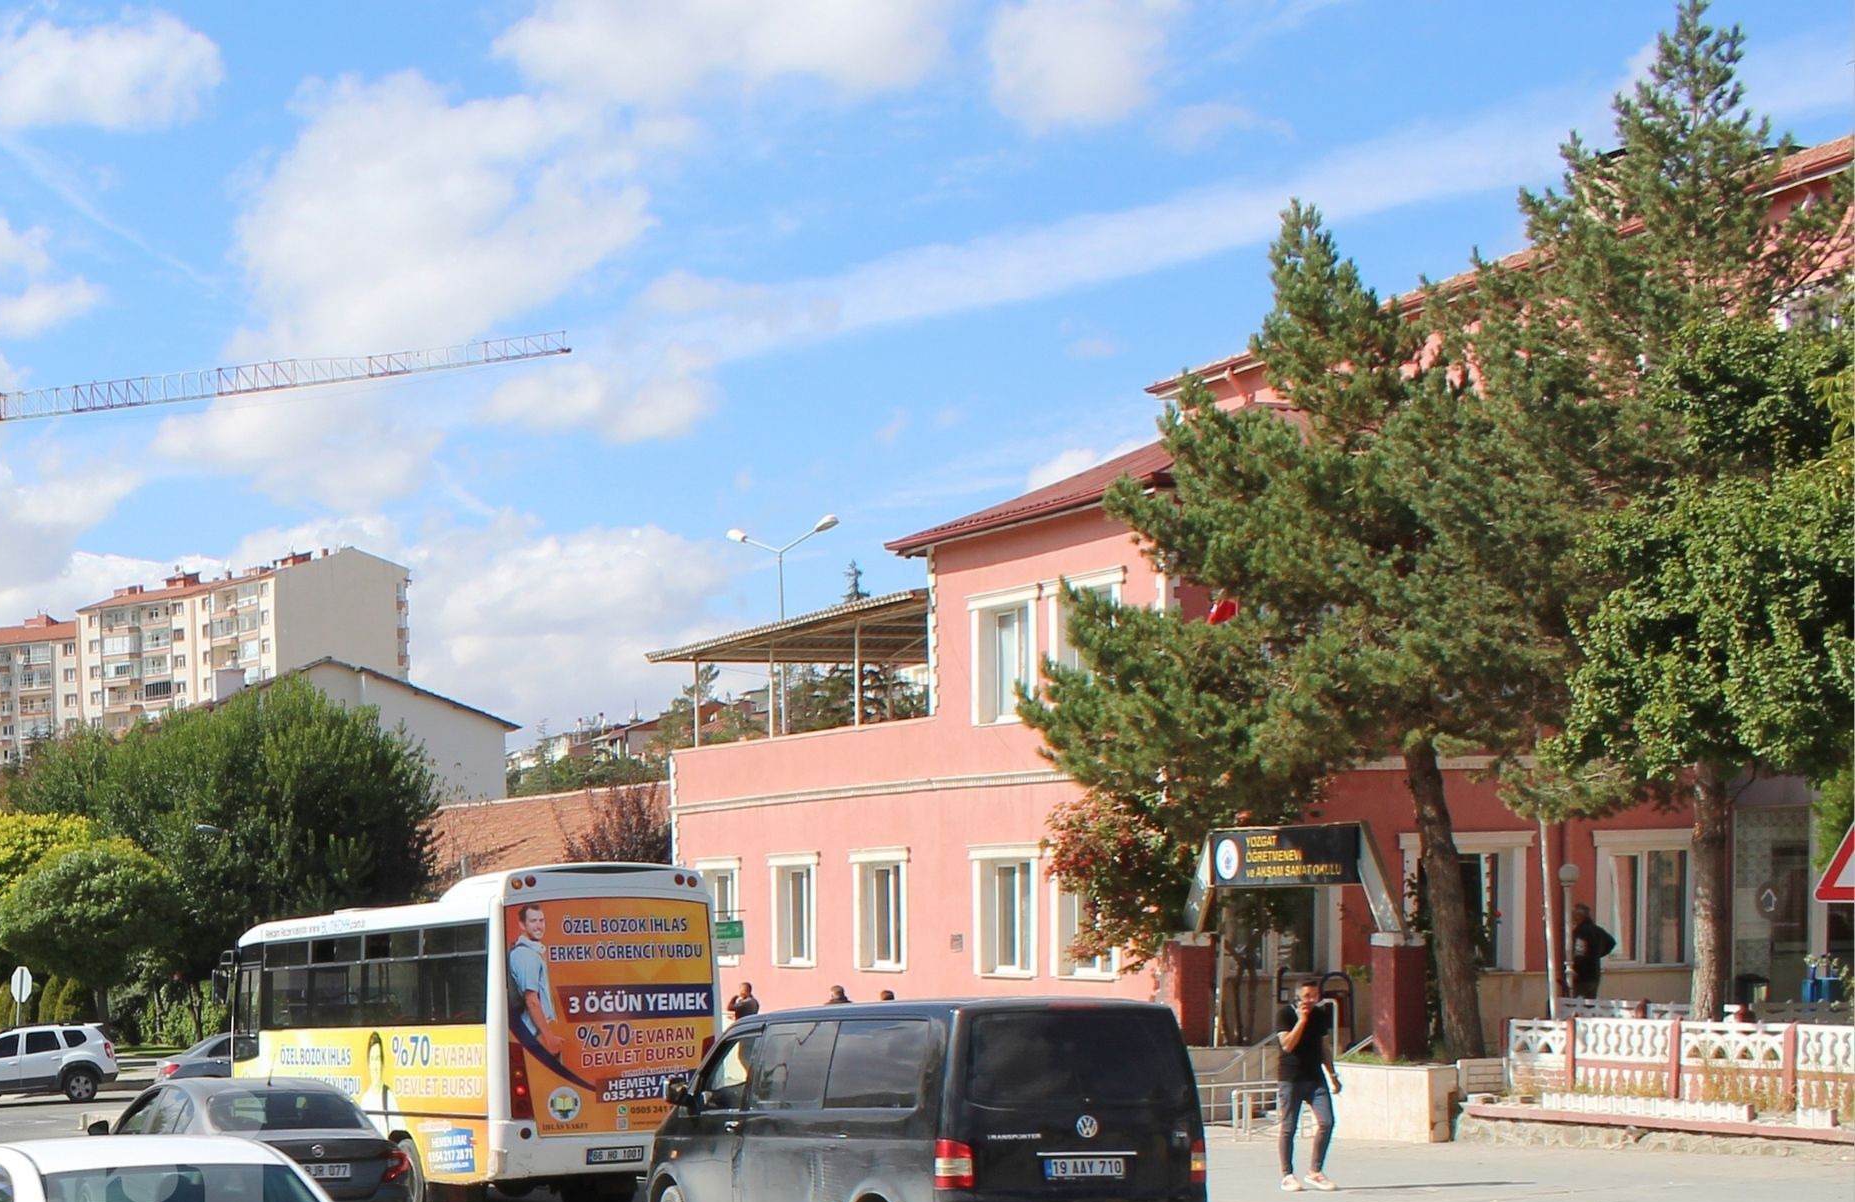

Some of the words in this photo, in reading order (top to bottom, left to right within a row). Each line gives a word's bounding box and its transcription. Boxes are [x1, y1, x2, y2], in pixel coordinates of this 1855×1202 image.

[1245, 835, 1278, 848] YOZGAT
[1284, 864, 1312, 877] SANAT
[562, 914, 597, 934] ÖZEL
[601, 917, 647, 934] BOZOK
[649, 914, 688, 933] İHLAS
[549, 945, 593, 961] ERKEK
[596, 940, 656, 960] ÖĞRENCİ
[657, 943, 704, 959] YURDU
[568, 996, 581, 1014] 3
[584, 990, 642, 1014] ÖĞÜN
[645, 992, 708, 1012] YEMEK
[645, 1026, 695, 1043] VARAN
[279, 1043, 299, 1065] ÖZEL
[300, 1047, 327, 1066] BOZOK
[327, 1043, 352, 1066] İHLAS
[442, 1046, 483, 1066] VARAN
[581, 1050, 642, 1067] DEVLET
[645, 1045, 696, 1062] BURSU
[394, 1077, 440, 1095] DEVLET
[441, 1078, 483, 1096] BURSU
[608, 1076, 656, 1091] HEMEN
[602, 1087, 635, 1101] 0354
[636, 1086, 660, 1098] 217
[328, 1165, 347, 1176] 077
[1052, 1160, 1067, 1175] 19
[1072, 1160, 1094, 1175] AAY
[1098, 1160, 1122, 1174] 710
